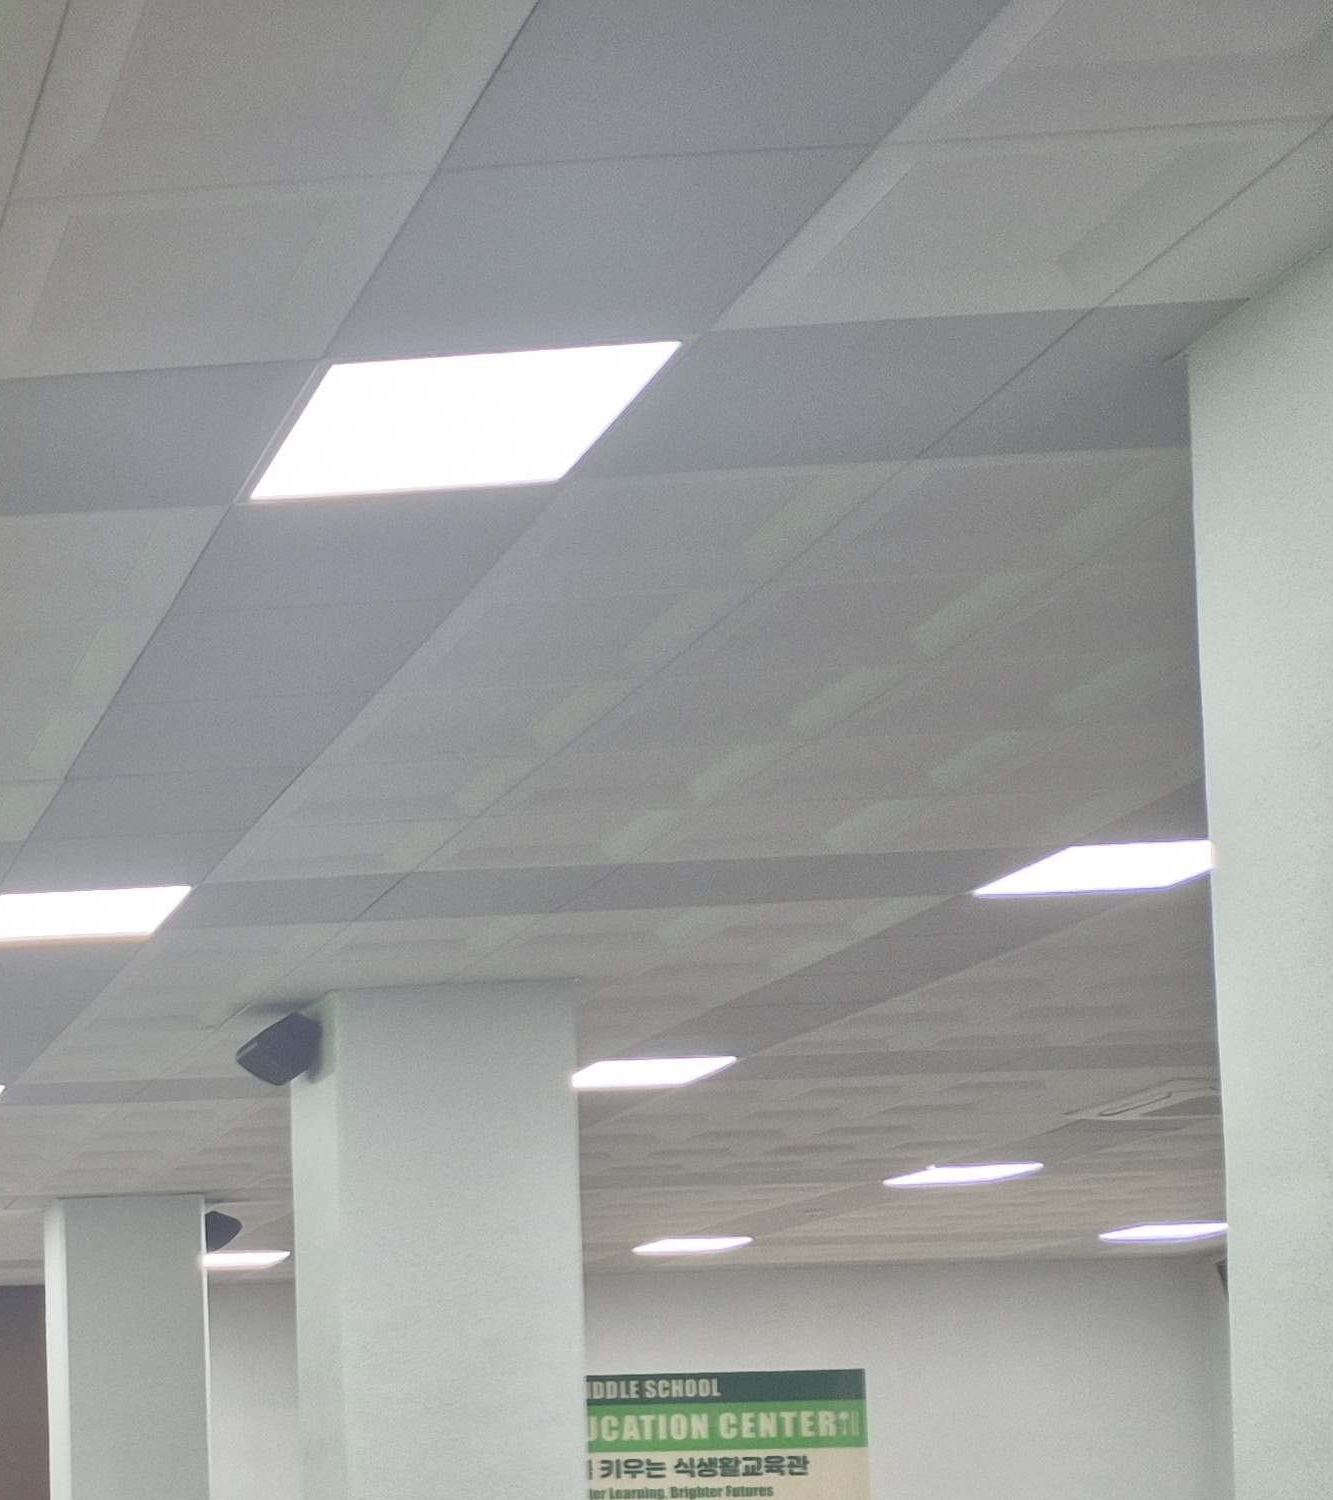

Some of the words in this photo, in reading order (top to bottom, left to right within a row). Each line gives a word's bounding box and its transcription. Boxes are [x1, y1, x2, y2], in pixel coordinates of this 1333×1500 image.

[587, 1380, 640, 1399] IDDLE
[645, 1378, 721, 1398] SCHOOL
[587, 1412, 709, 1442] UCATION
[719, 1410, 837, 1439] CENTER
[600, 1458, 667, 1480] 키우는
[674, 1455, 810, 1479] 식생활교육관
[670, 1486, 723, 1500] Brighter
[726, 1485, 774, 1498] Futures
